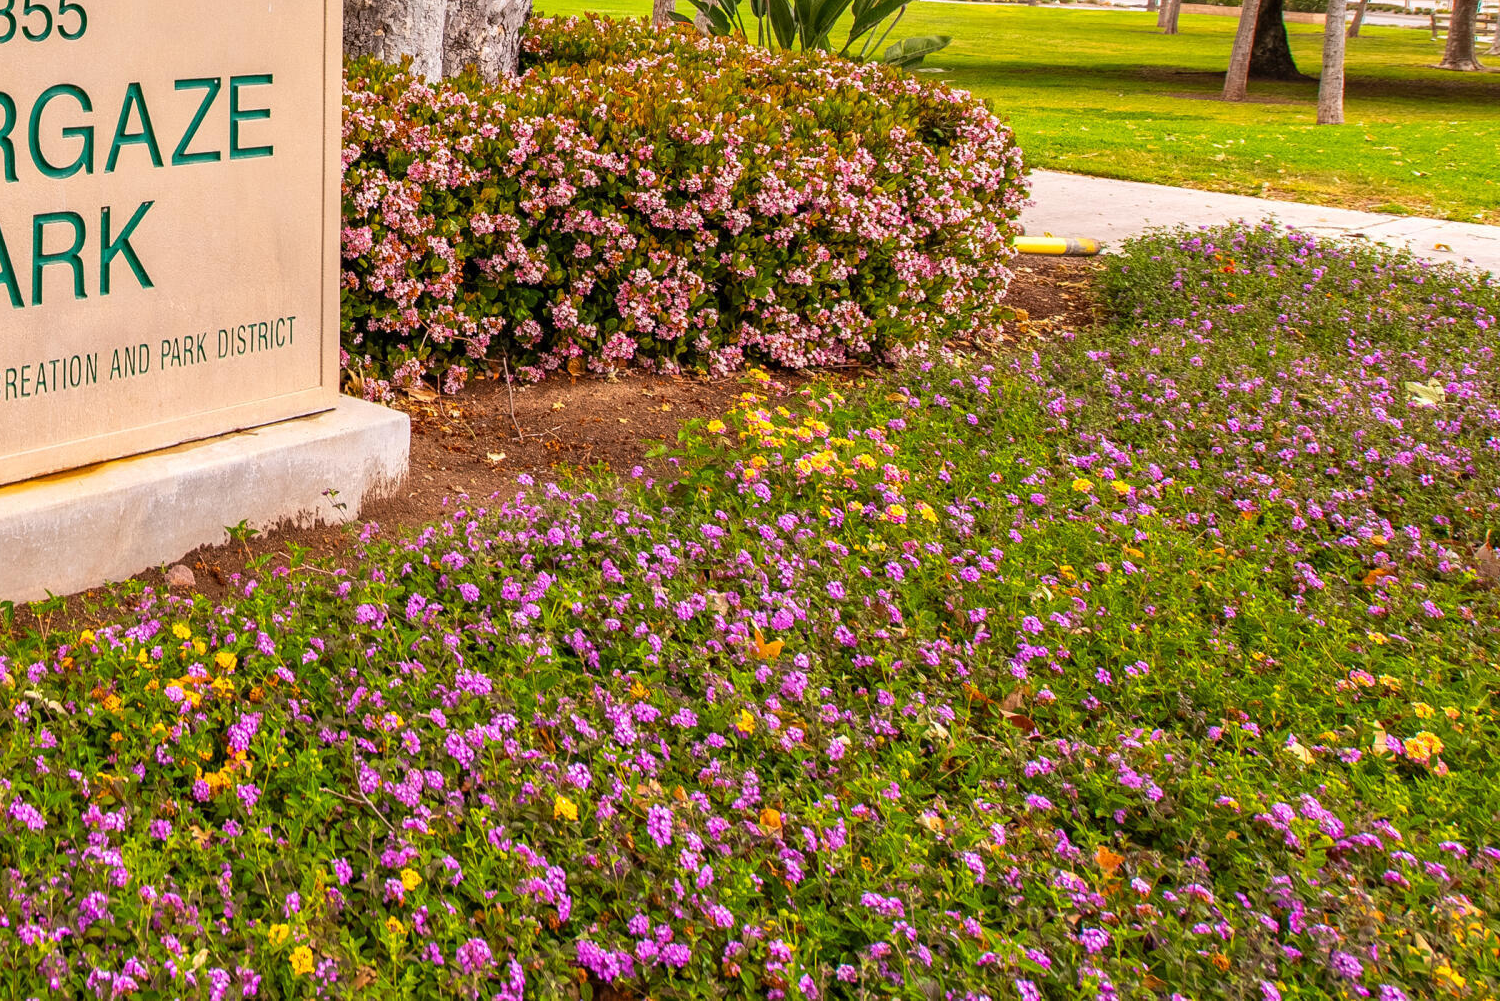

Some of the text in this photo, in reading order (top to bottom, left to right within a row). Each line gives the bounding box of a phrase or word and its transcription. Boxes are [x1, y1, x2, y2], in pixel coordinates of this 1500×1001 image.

[110, 343, 150, 378] AND
[161, 335, 207, 370] PARK
[218, 316, 296, 359] DISTRICT
